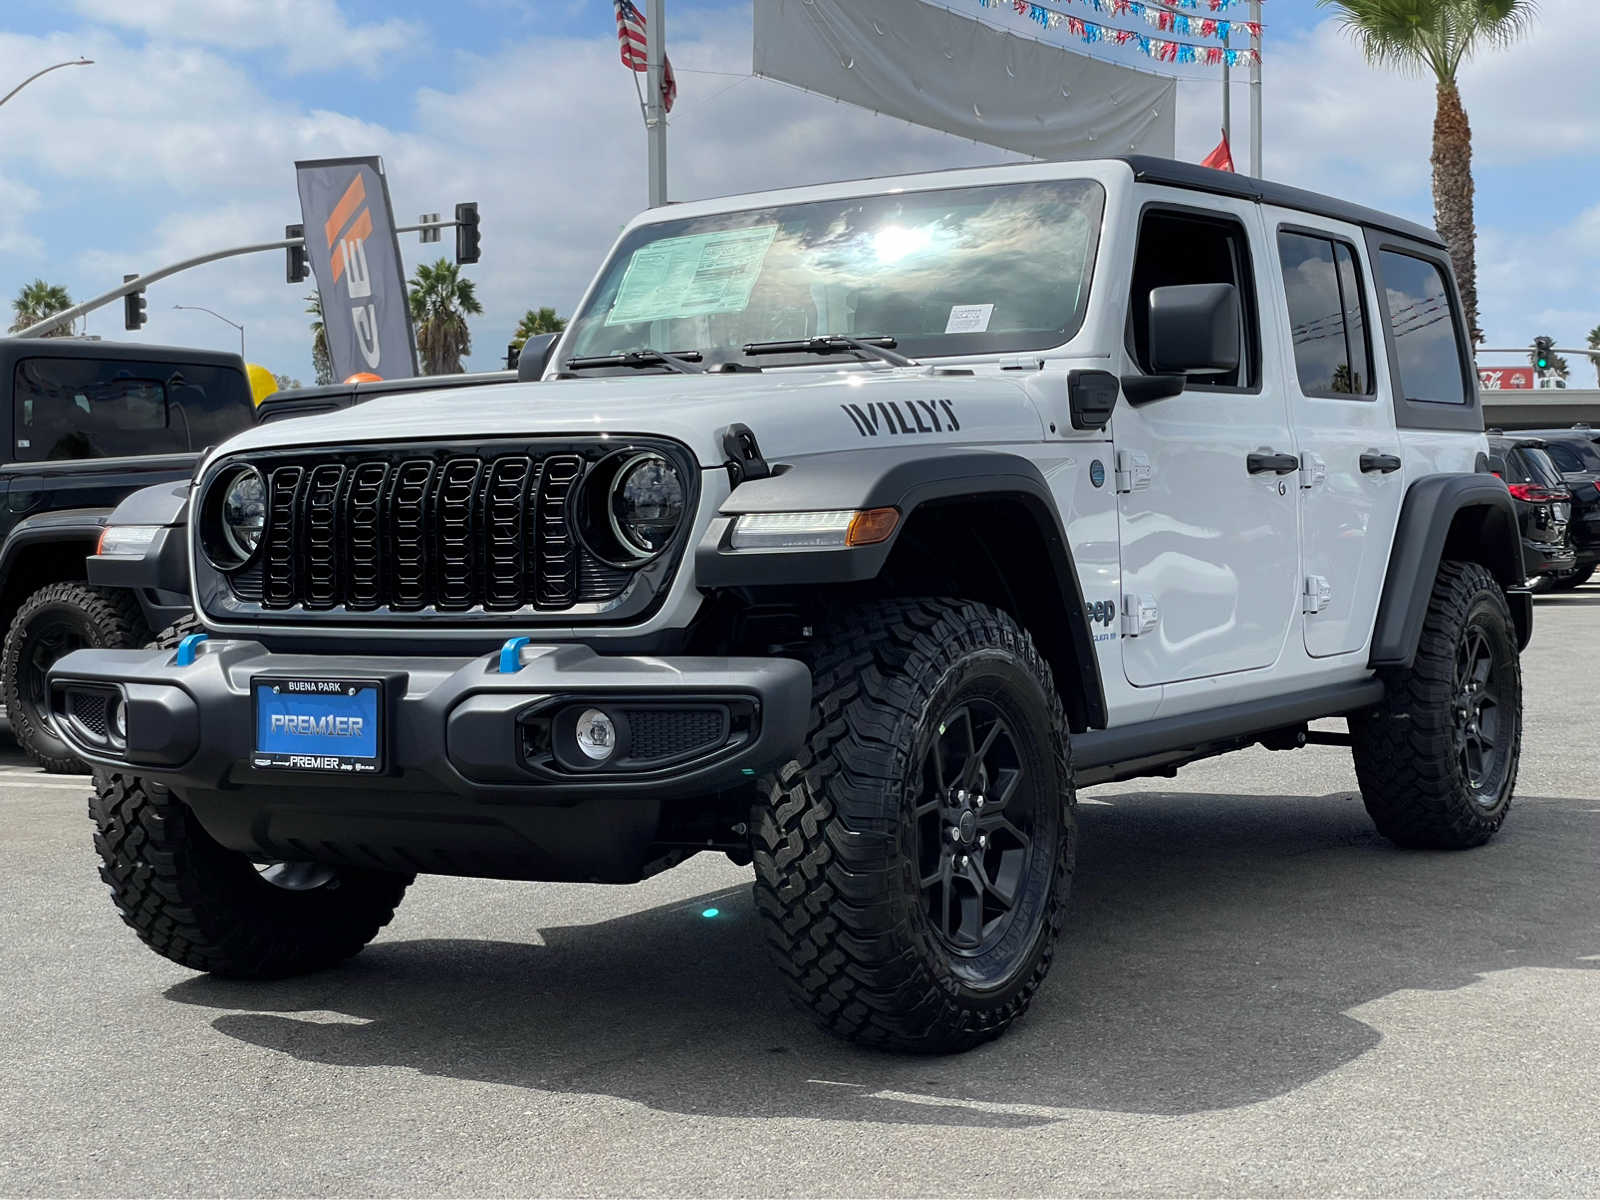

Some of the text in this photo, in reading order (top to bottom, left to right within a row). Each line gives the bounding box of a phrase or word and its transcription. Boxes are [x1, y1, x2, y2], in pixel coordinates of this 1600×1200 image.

[839, 399, 960, 437] WILLYS
[1086, 600, 1116, 627] eep
[288, 681, 342, 692] BUENA PARK
[289, 755, 340, 770] PREMIER
